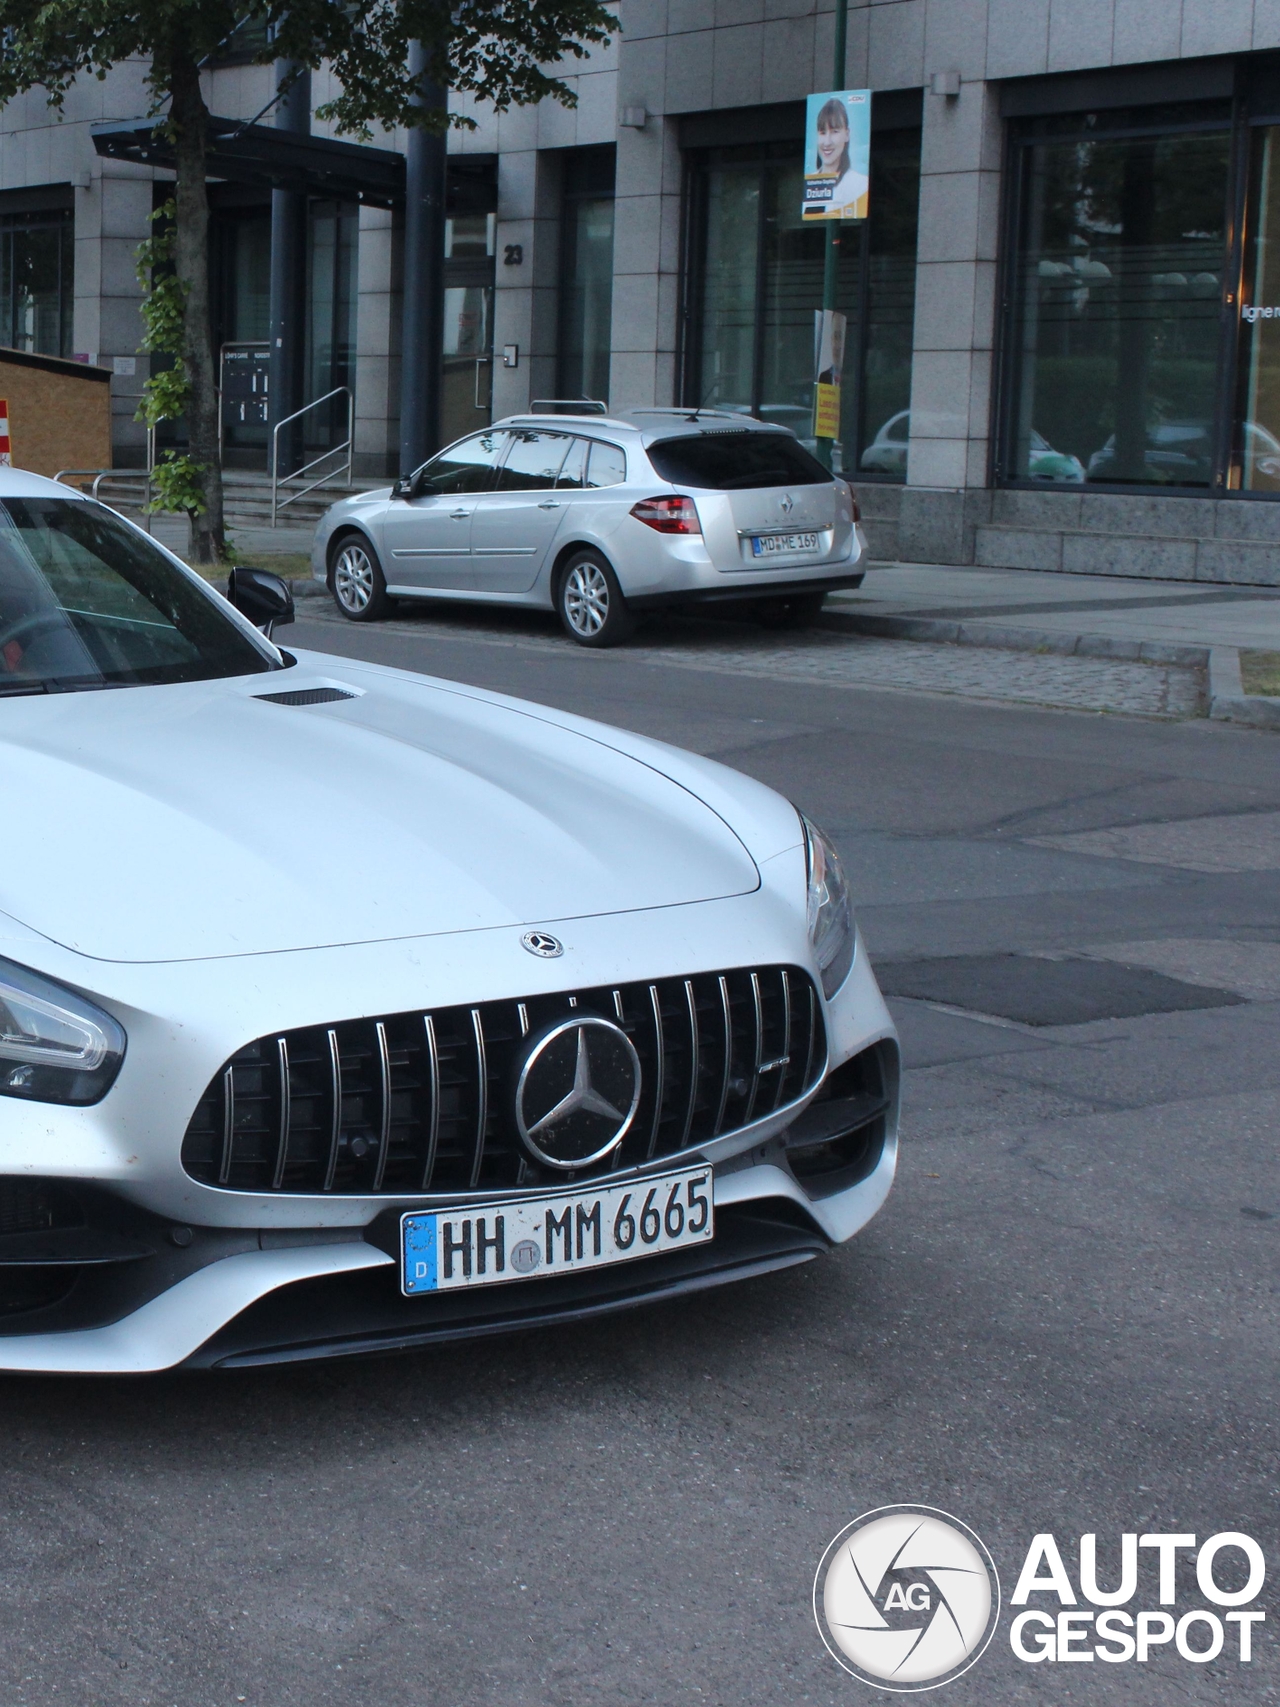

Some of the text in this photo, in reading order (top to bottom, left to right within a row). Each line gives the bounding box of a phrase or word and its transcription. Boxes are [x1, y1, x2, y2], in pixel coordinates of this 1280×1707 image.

[504, 244, 523, 265] 23
[781, 536, 796, 549] ME
[797, 534, 817, 549] 169
[443, 1176, 708, 1279] HH MM 6665
[415, 1261, 428, 1279] D
